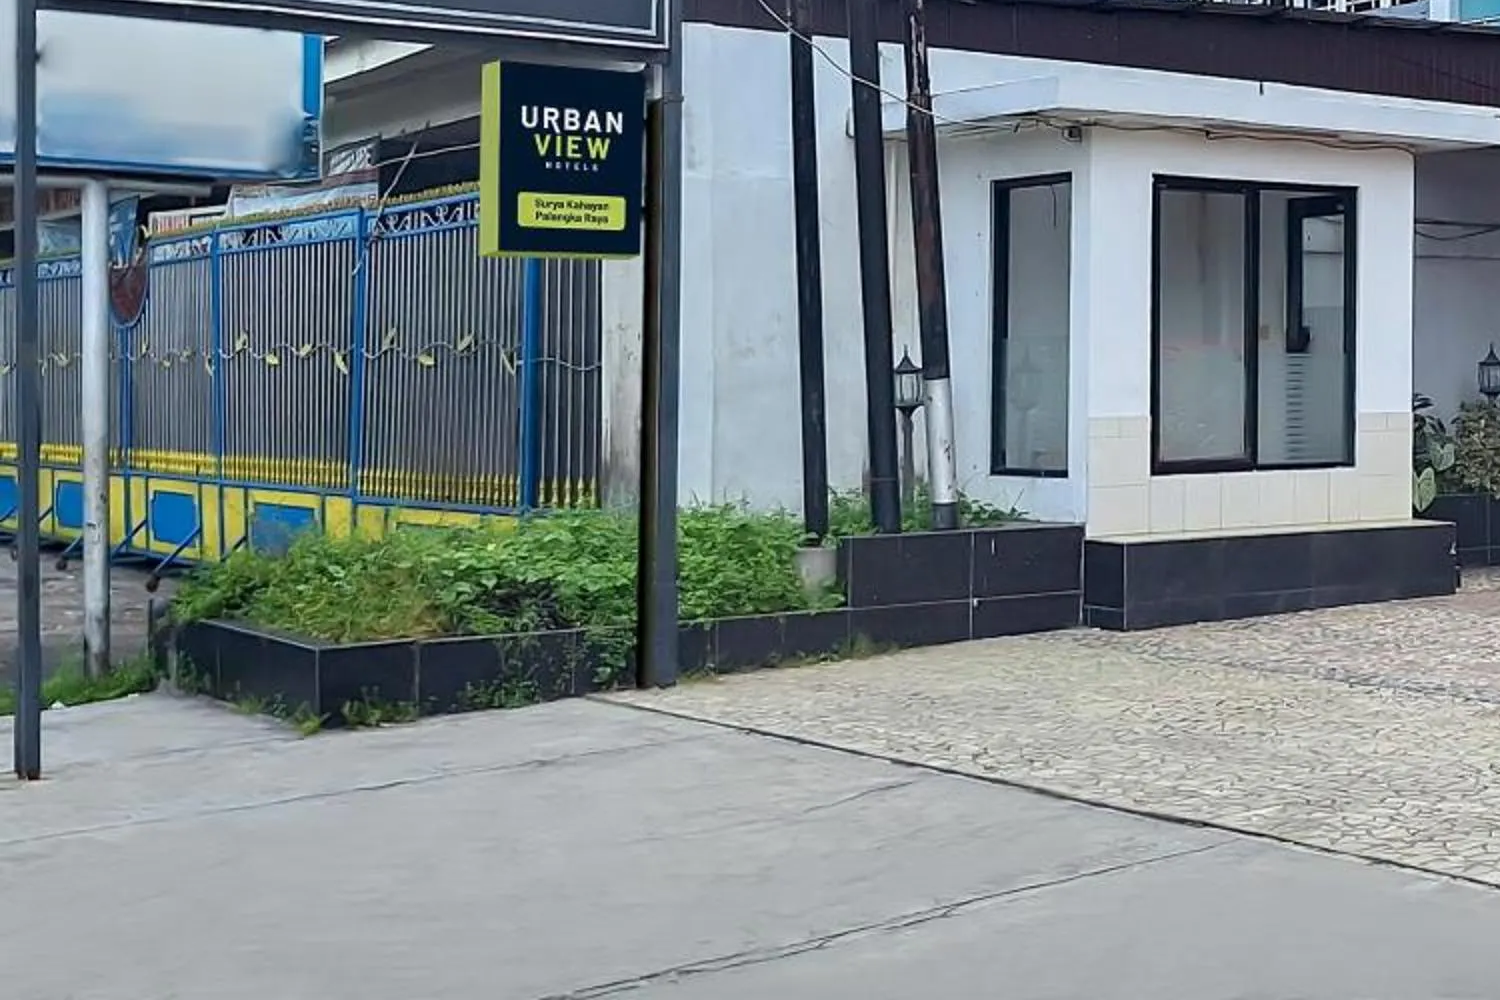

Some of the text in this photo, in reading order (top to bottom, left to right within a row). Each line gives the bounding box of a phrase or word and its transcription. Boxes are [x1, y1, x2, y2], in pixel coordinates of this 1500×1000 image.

[521, 105, 623, 134] URBAN
[534, 133, 610, 160] VIEW
[535, 199, 565, 210] Surya
